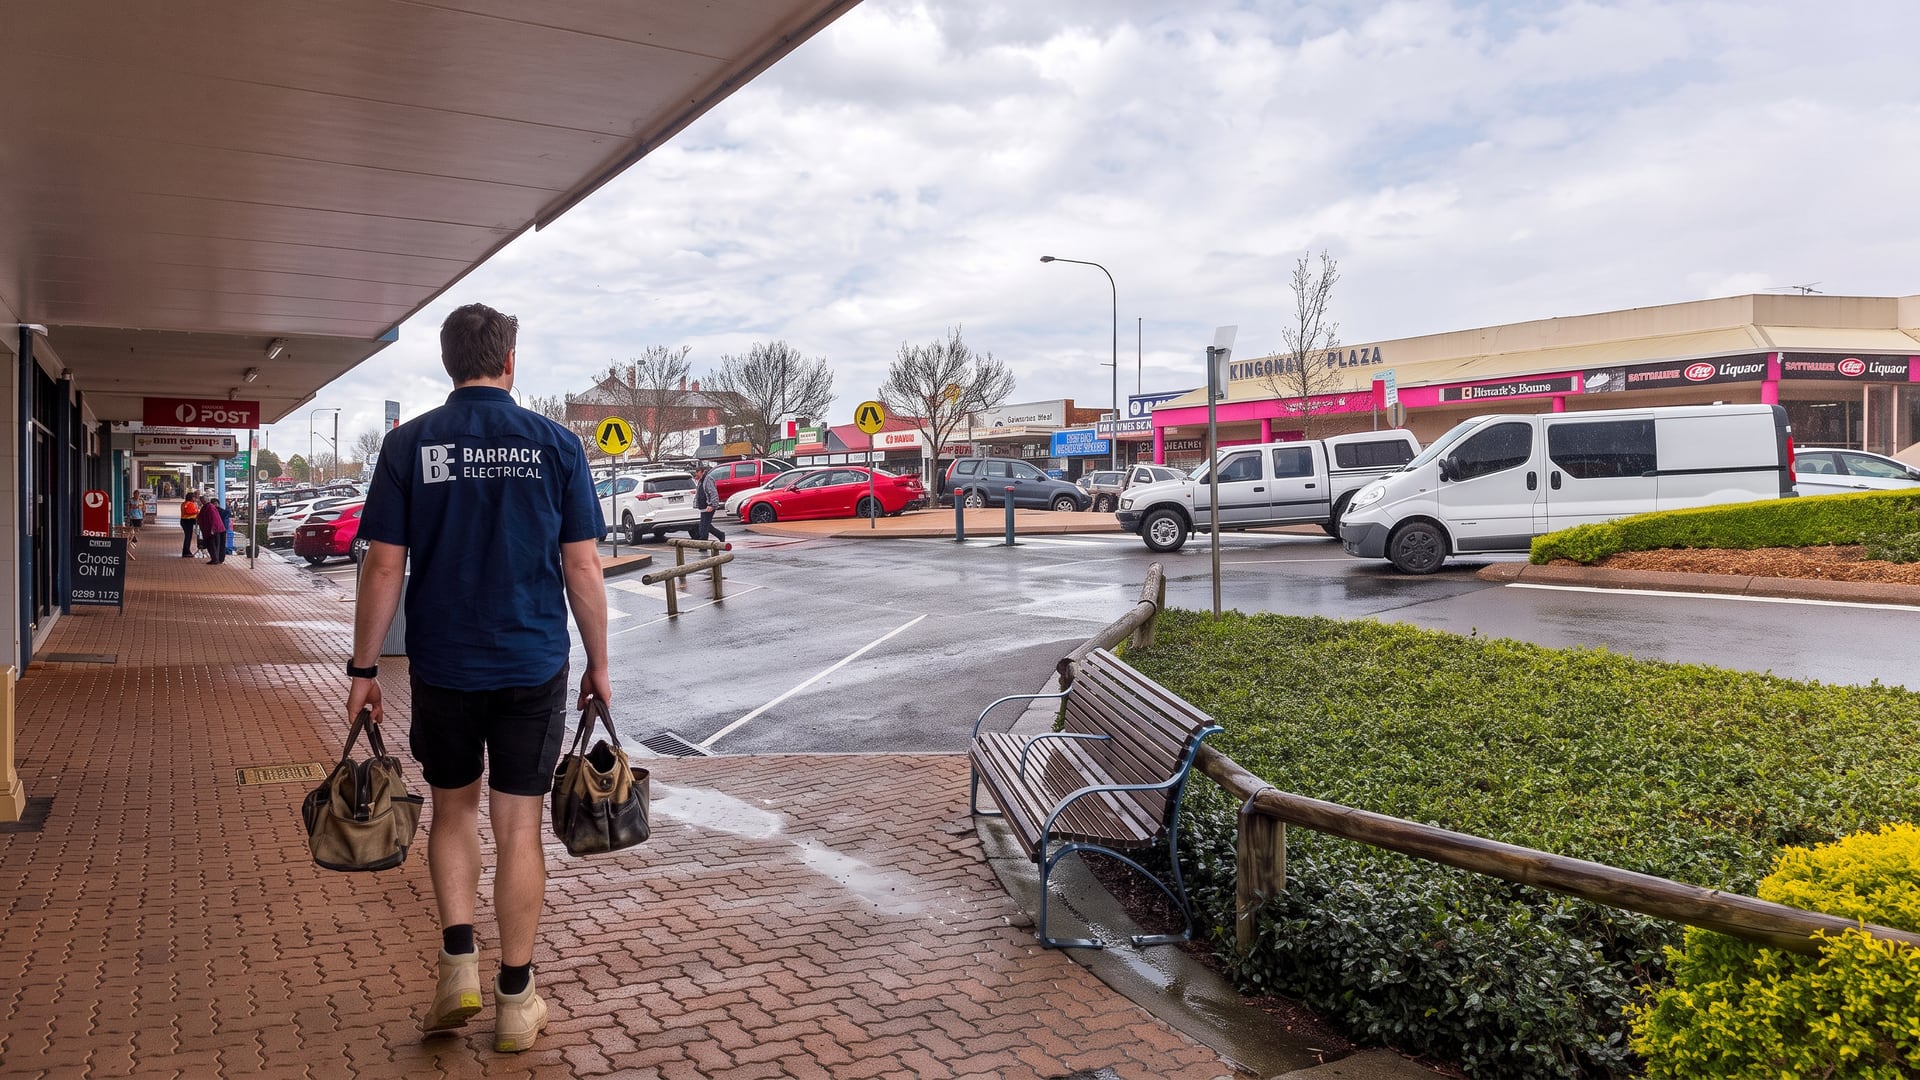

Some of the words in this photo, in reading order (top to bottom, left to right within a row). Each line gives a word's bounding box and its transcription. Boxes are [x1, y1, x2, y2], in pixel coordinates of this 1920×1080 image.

[1327, 346, 1383, 369] PLAZA
[201, 410, 251, 424] POST
[463, 447, 542, 464] BARRACK
[464, 466, 543, 479] ELECTRICAL
[79, 565, 98, 576] ON
